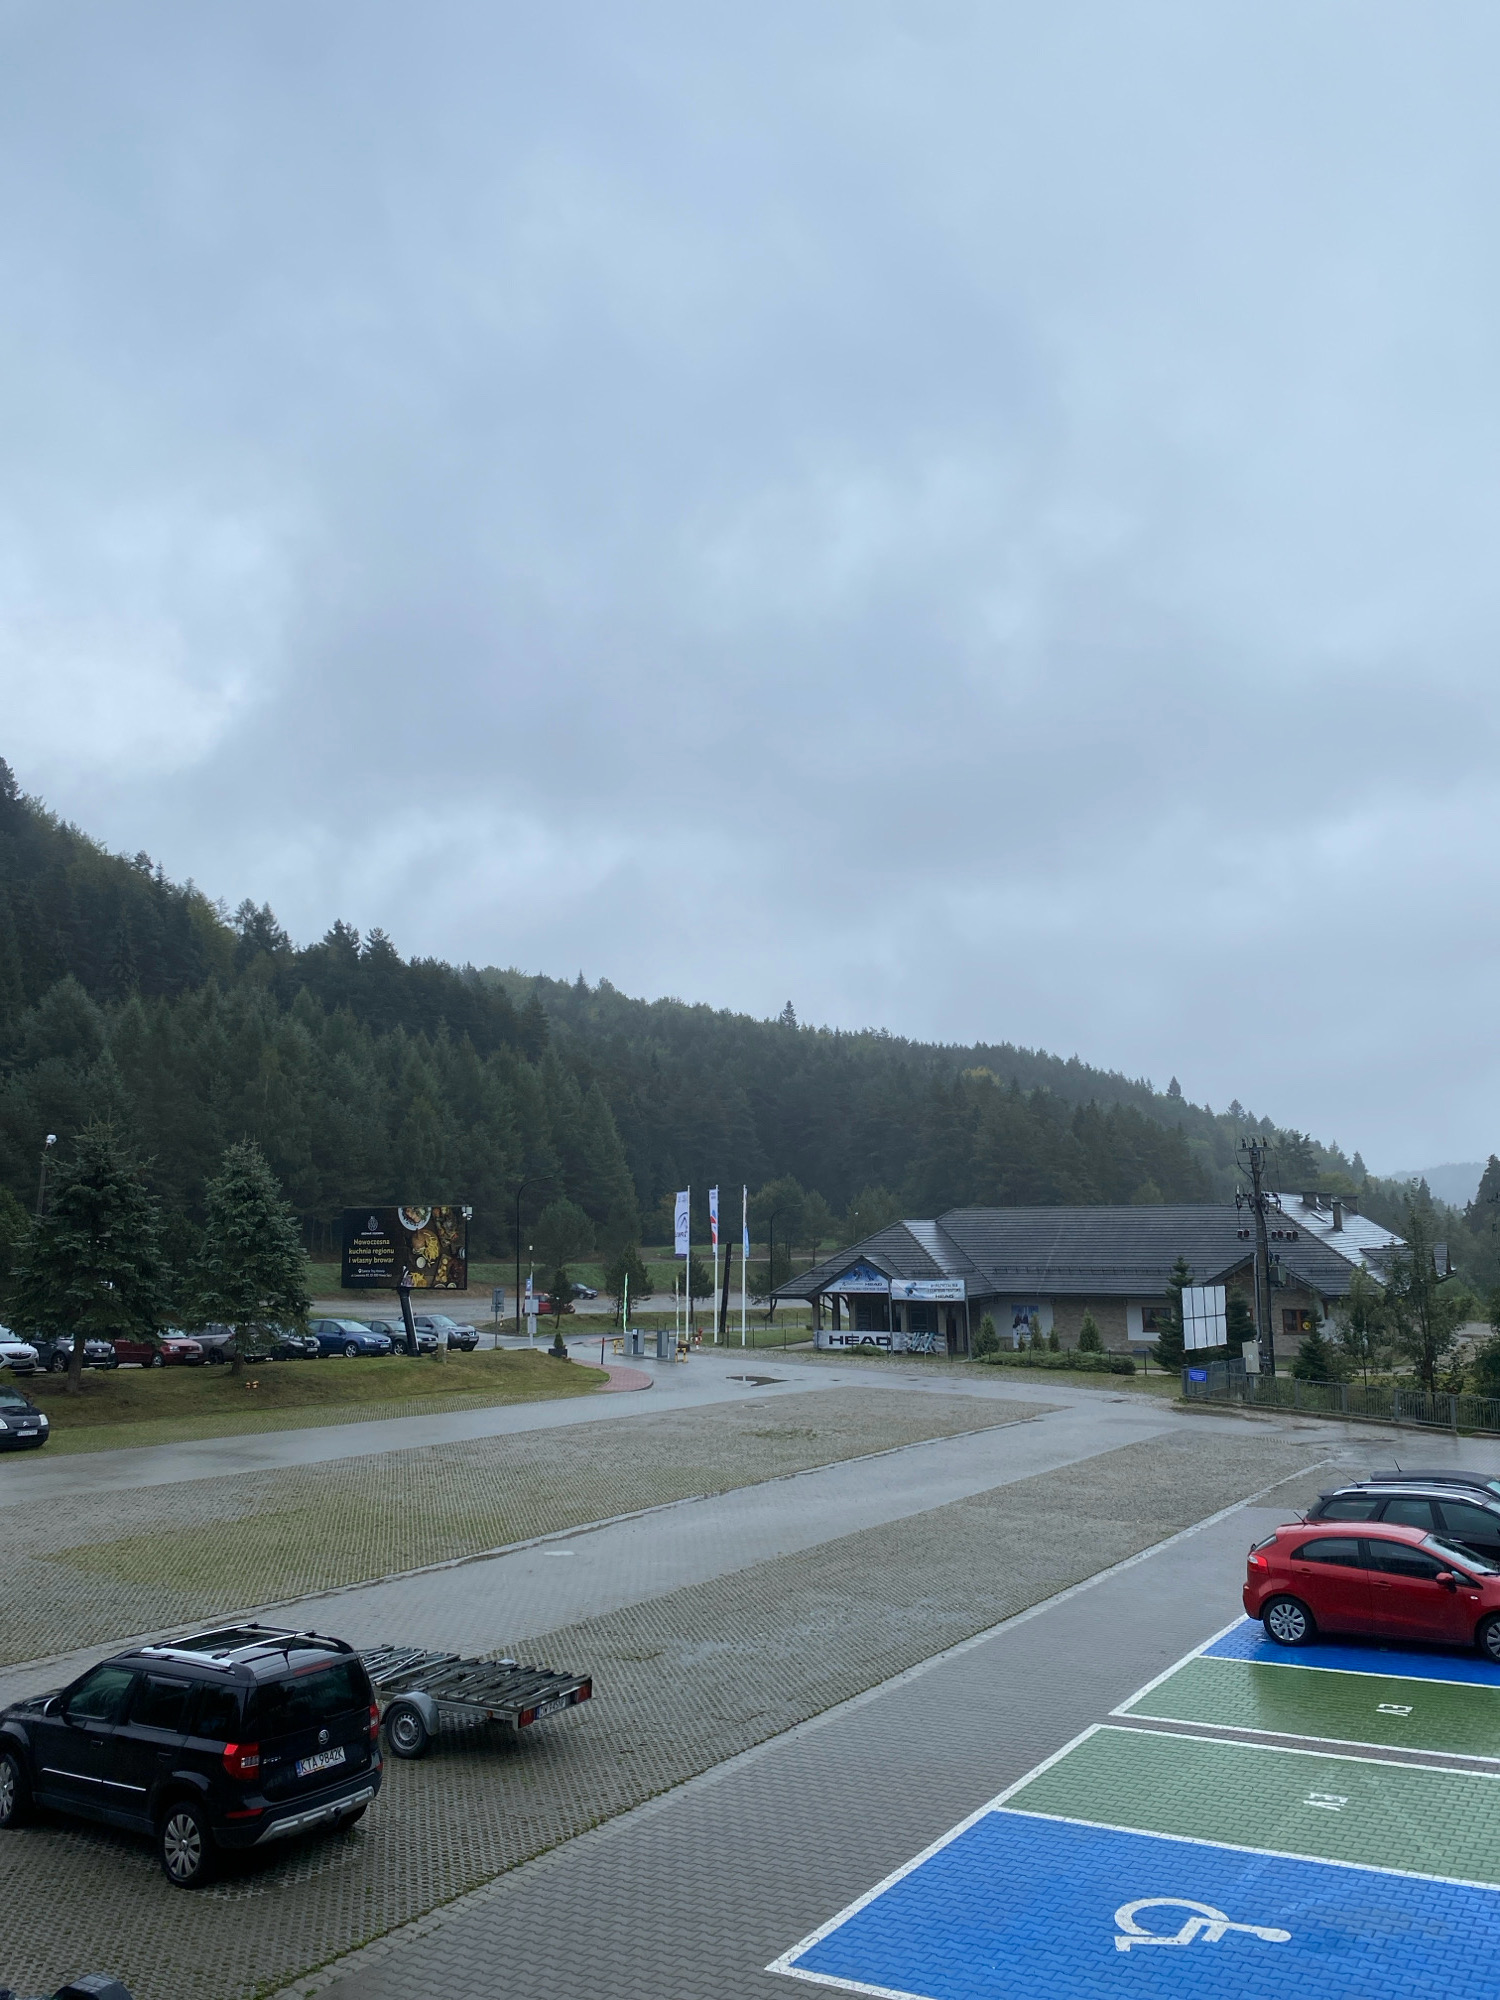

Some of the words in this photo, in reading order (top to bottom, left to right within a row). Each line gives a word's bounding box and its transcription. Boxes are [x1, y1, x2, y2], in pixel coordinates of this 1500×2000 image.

[353, 1238, 390, 1246] Nowoczesna
[348, 1247, 372, 1255] kuchnia
[372, 1247, 395, 1256] regionu
[373, 1256, 394, 1264] browar
[828, 1335, 892, 1346] HEAD
[1375, 1703, 1414, 1717] EV
[300, 1756, 318, 1773] KTA
[318, 1747, 344, 1765] 9842K
[1302, 1792, 1349, 1812] EV
